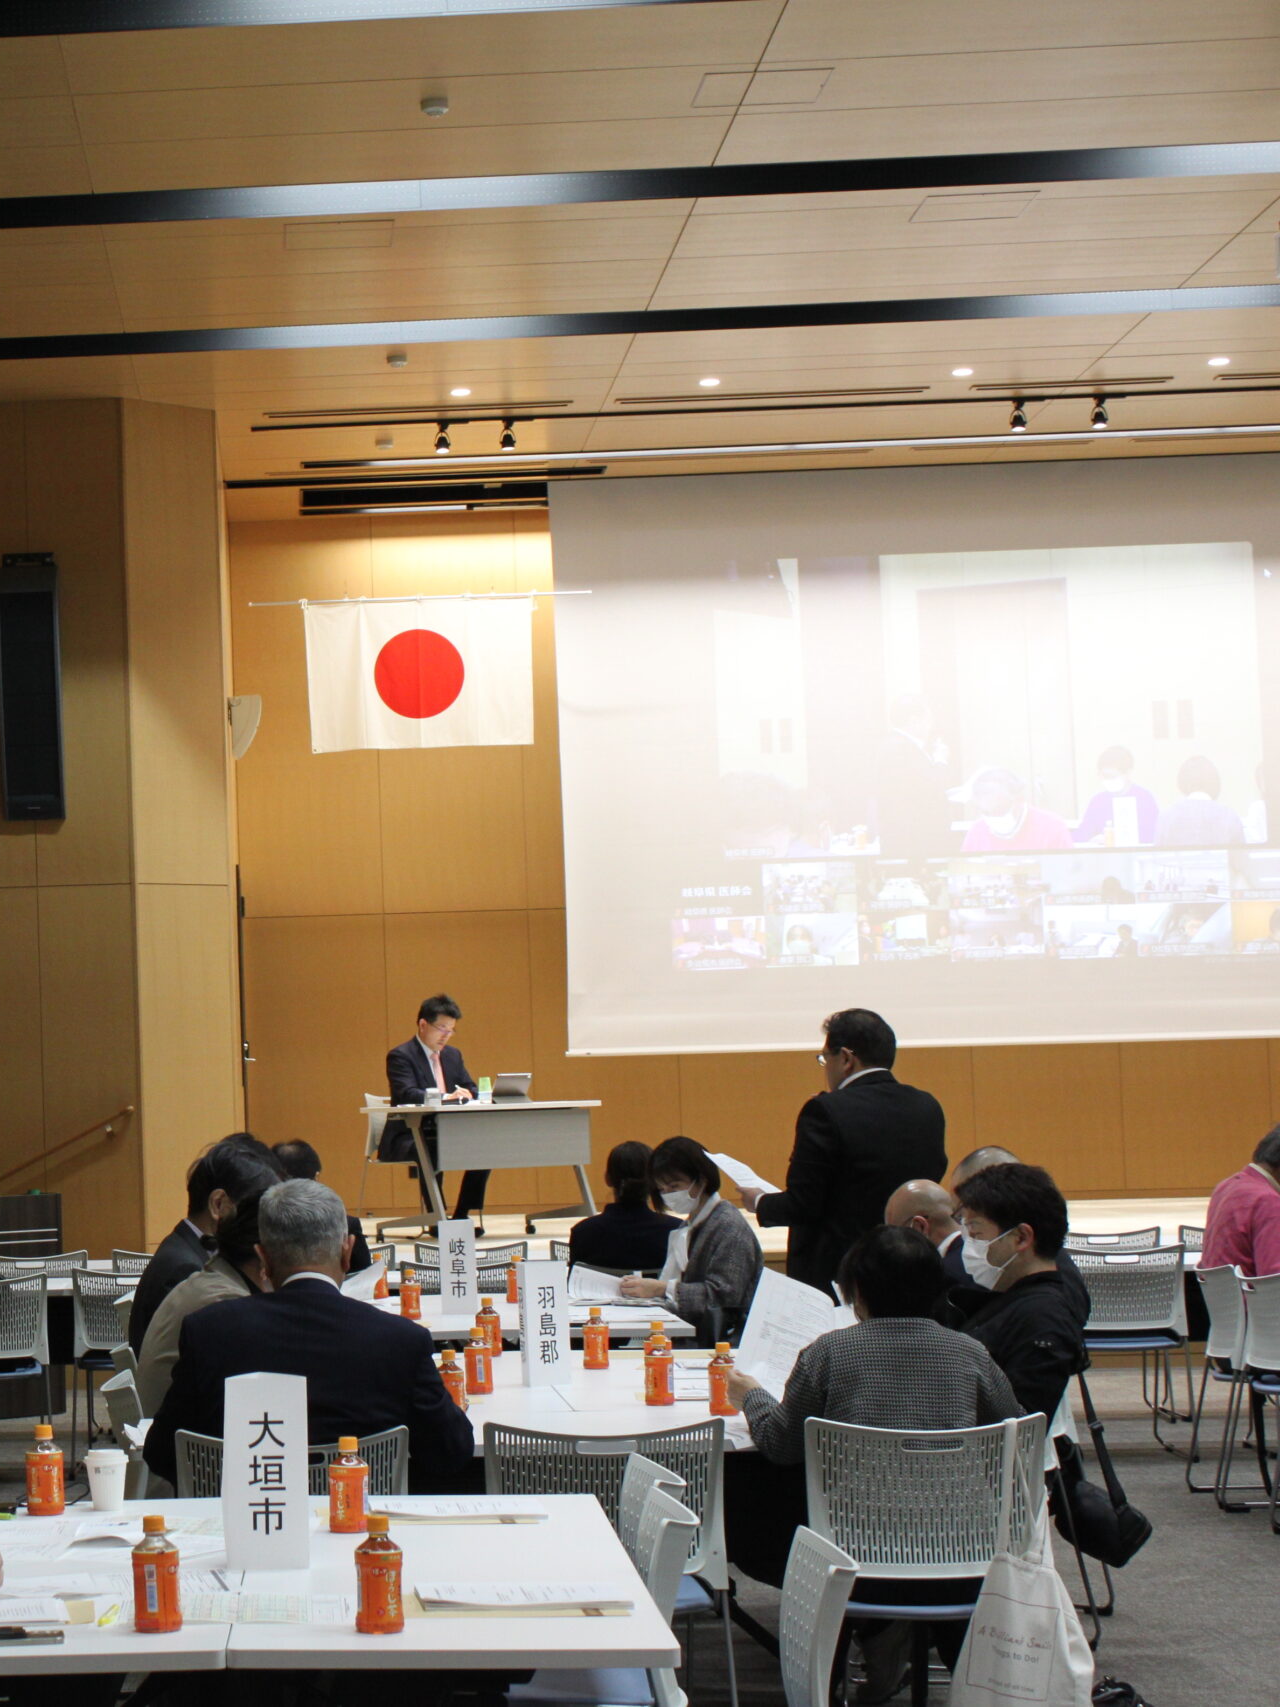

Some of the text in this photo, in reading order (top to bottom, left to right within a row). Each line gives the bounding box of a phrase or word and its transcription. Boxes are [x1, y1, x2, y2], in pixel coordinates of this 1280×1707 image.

[449, 1238, 467, 1298] 岐阜市
[538, 1286, 559, 1364] 羽島郡
[248, 1411, 286, 1535] 大垣市
[386, 1569, 399, 1618] ほうじ茶
